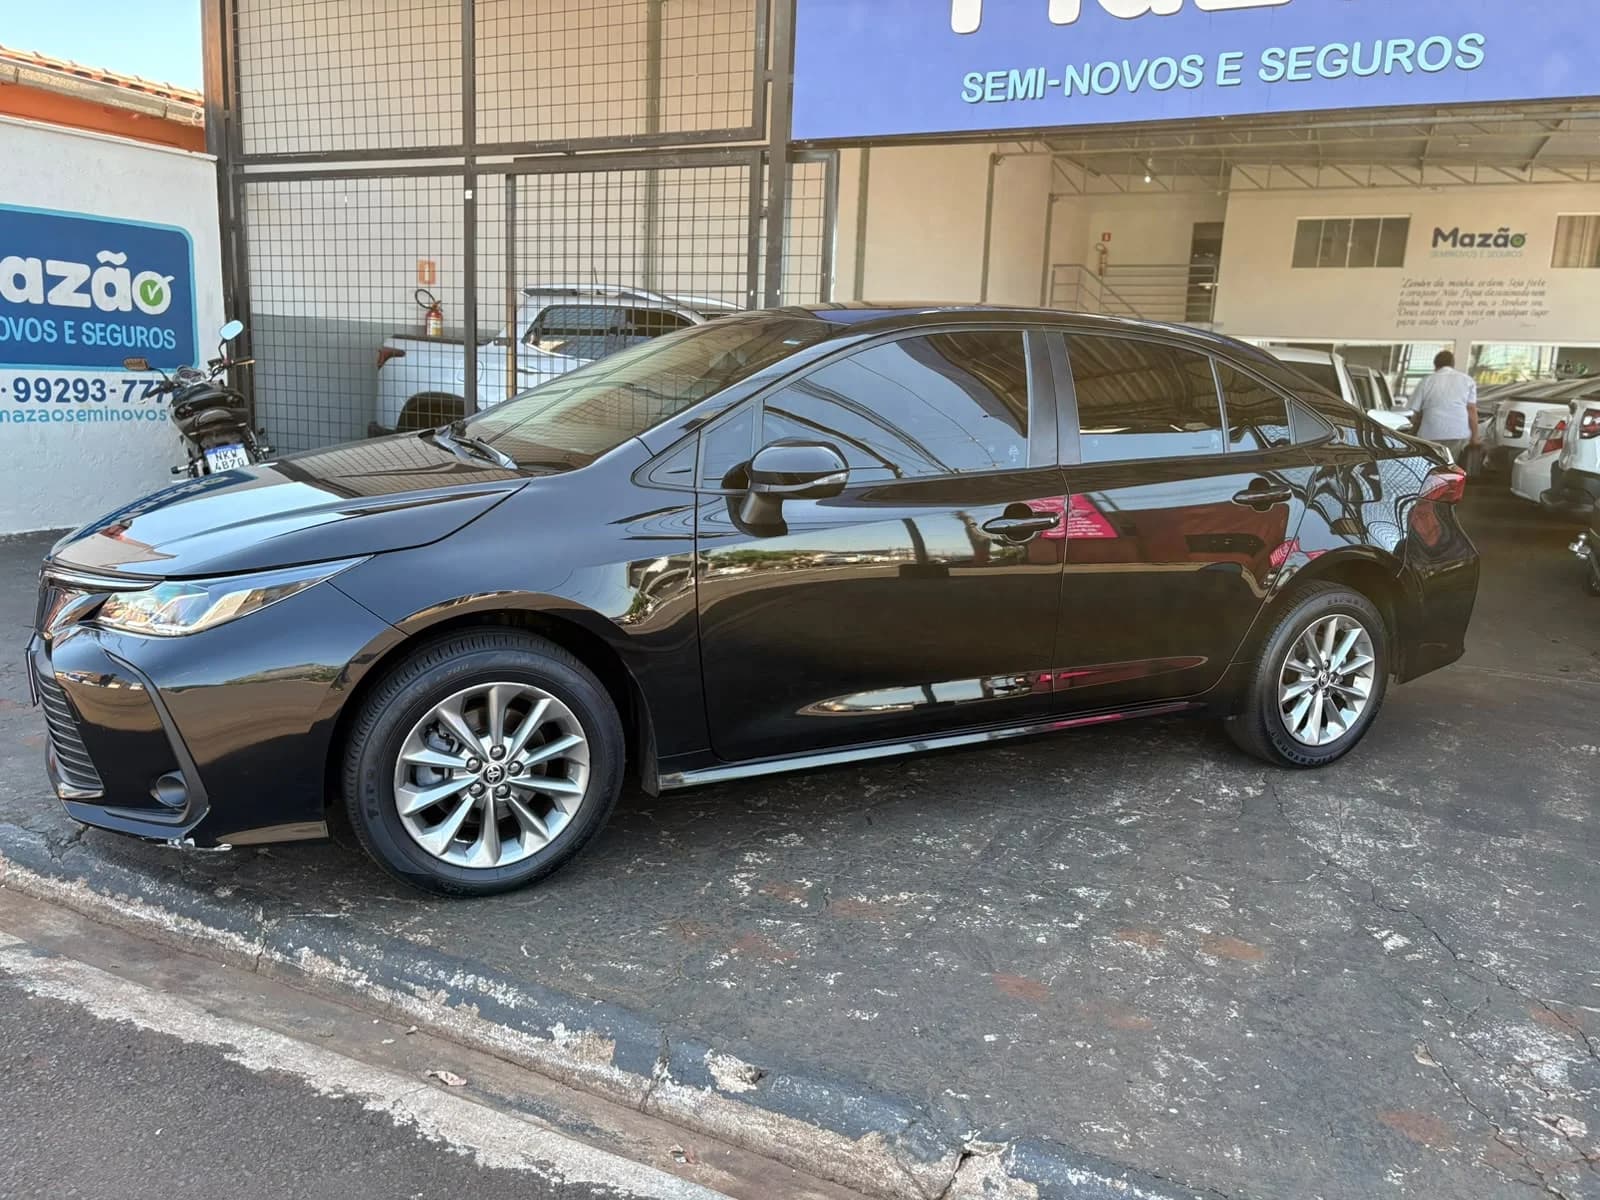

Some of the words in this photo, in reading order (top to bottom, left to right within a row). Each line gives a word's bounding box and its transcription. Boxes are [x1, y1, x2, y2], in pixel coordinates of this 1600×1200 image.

[961, 56, 1204, 104] SEMI-NOVOS
[1217, 52, 1244, 86] E
[1258, 32, 1486, 81] SEGUROS
[1431, 226, 1528, 248] Mazão
[64, 320, 76, 344] E
[82, 323, 176, 350] SEGUROS
